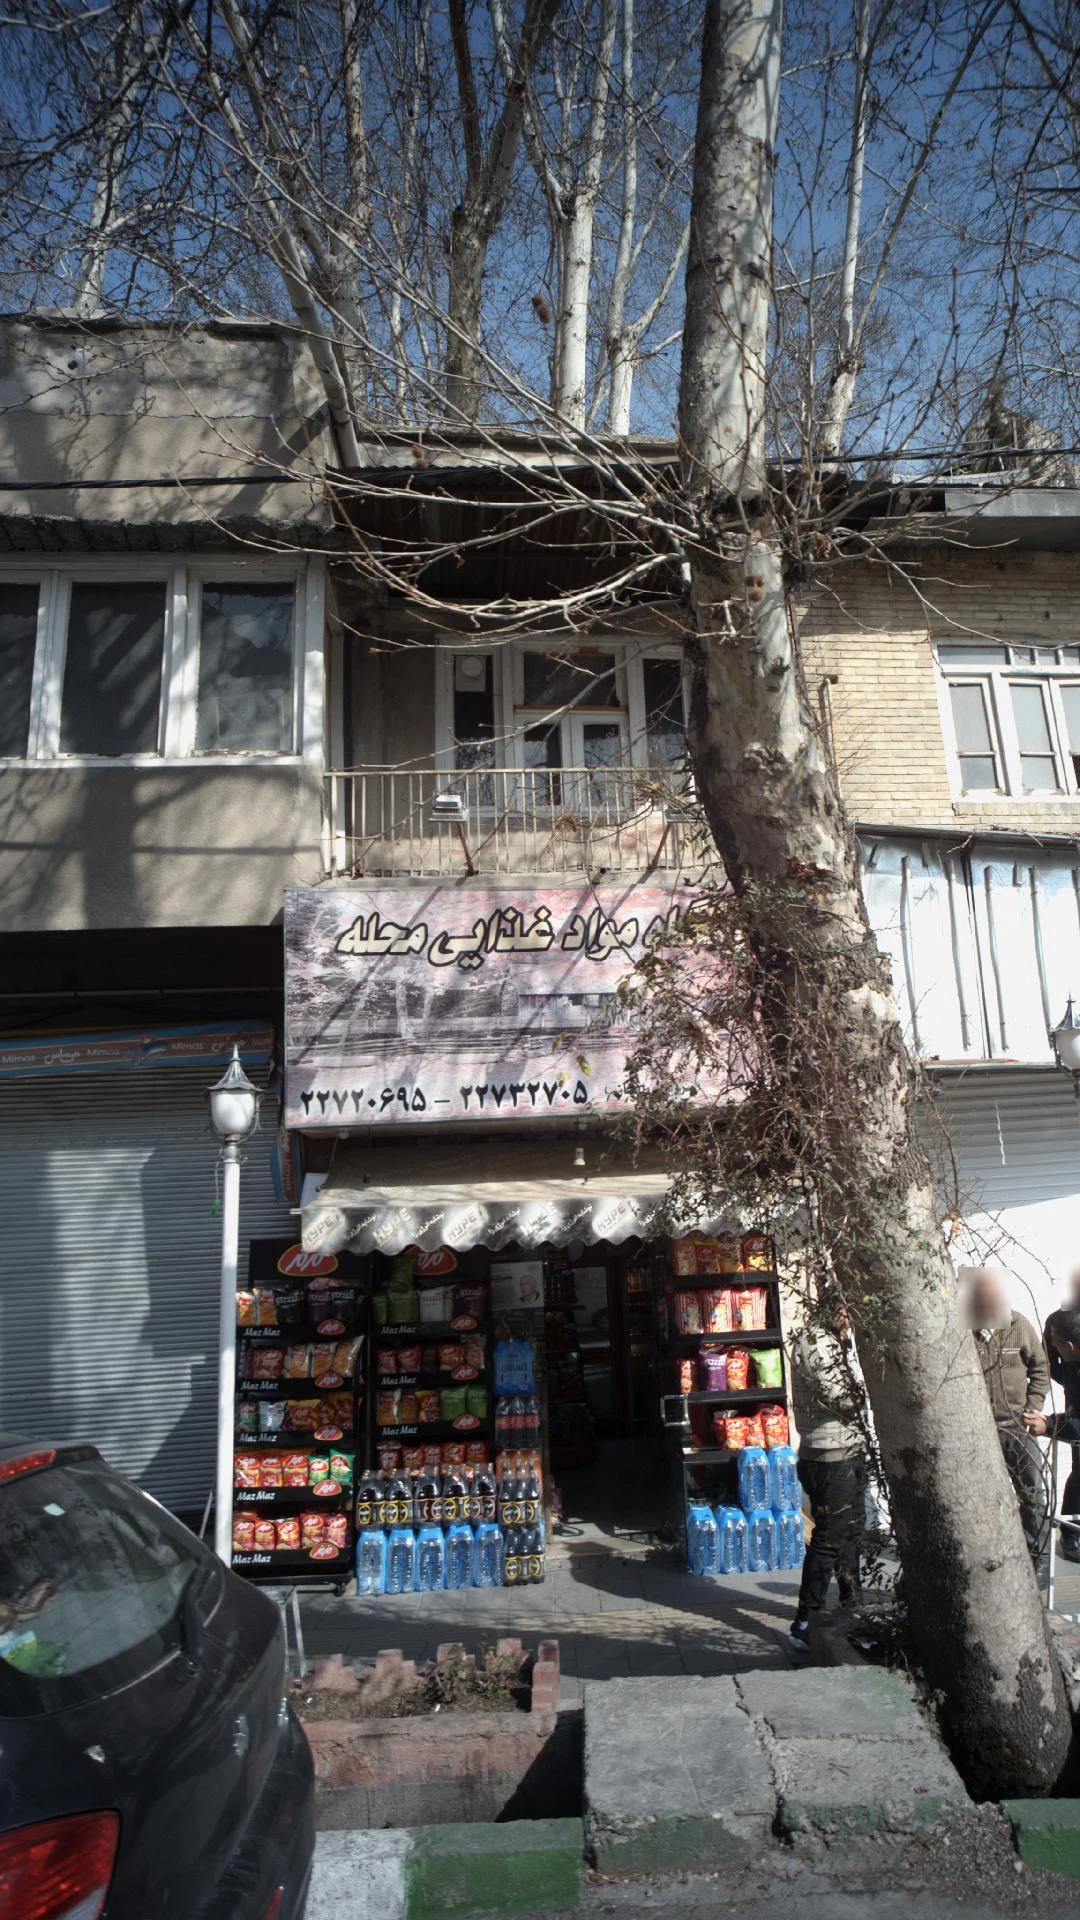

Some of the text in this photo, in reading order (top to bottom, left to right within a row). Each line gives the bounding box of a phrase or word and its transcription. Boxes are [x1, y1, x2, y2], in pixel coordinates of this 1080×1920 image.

[336, 911, 428, 956] محله
[429, 905, 554, 970] غذایی
[561, 906, 639, 962] مواد
[300, 1086, 426, 1116] ۲۲۷۲۰۶۹۵
[459, 1079, 588, 1110] ۲۲۷۳۲۷۰۵
[373, 1208, 412, 1243] HYPE
[448, 1213, 477, 1240] HYPE
[598, 1205, 625, 1232] HYPE
